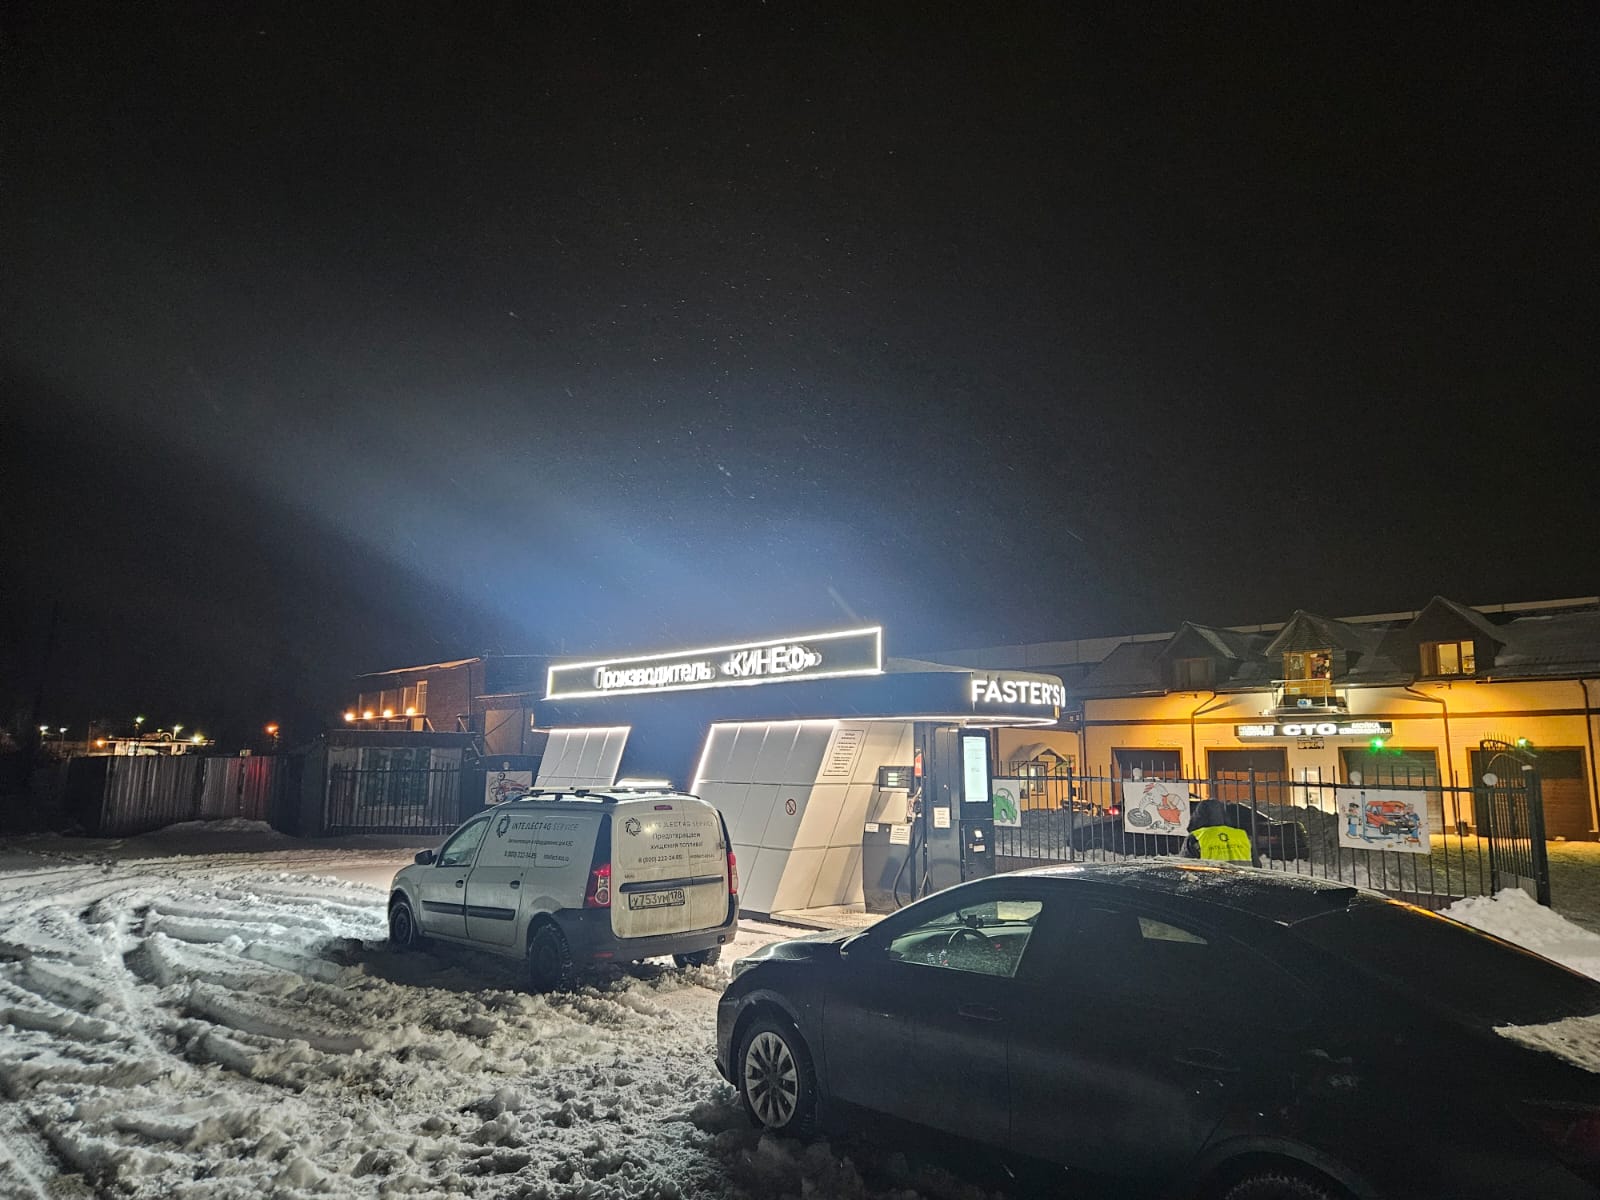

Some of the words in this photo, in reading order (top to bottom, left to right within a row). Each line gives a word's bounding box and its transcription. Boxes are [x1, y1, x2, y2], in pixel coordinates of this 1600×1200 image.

[595, 662, 715, 690] Производитель
[971, 680, 1060, 705] FASTER'S
[1283, 724, 1337, 735] СТО
[670, 890, 683, 900] 178
